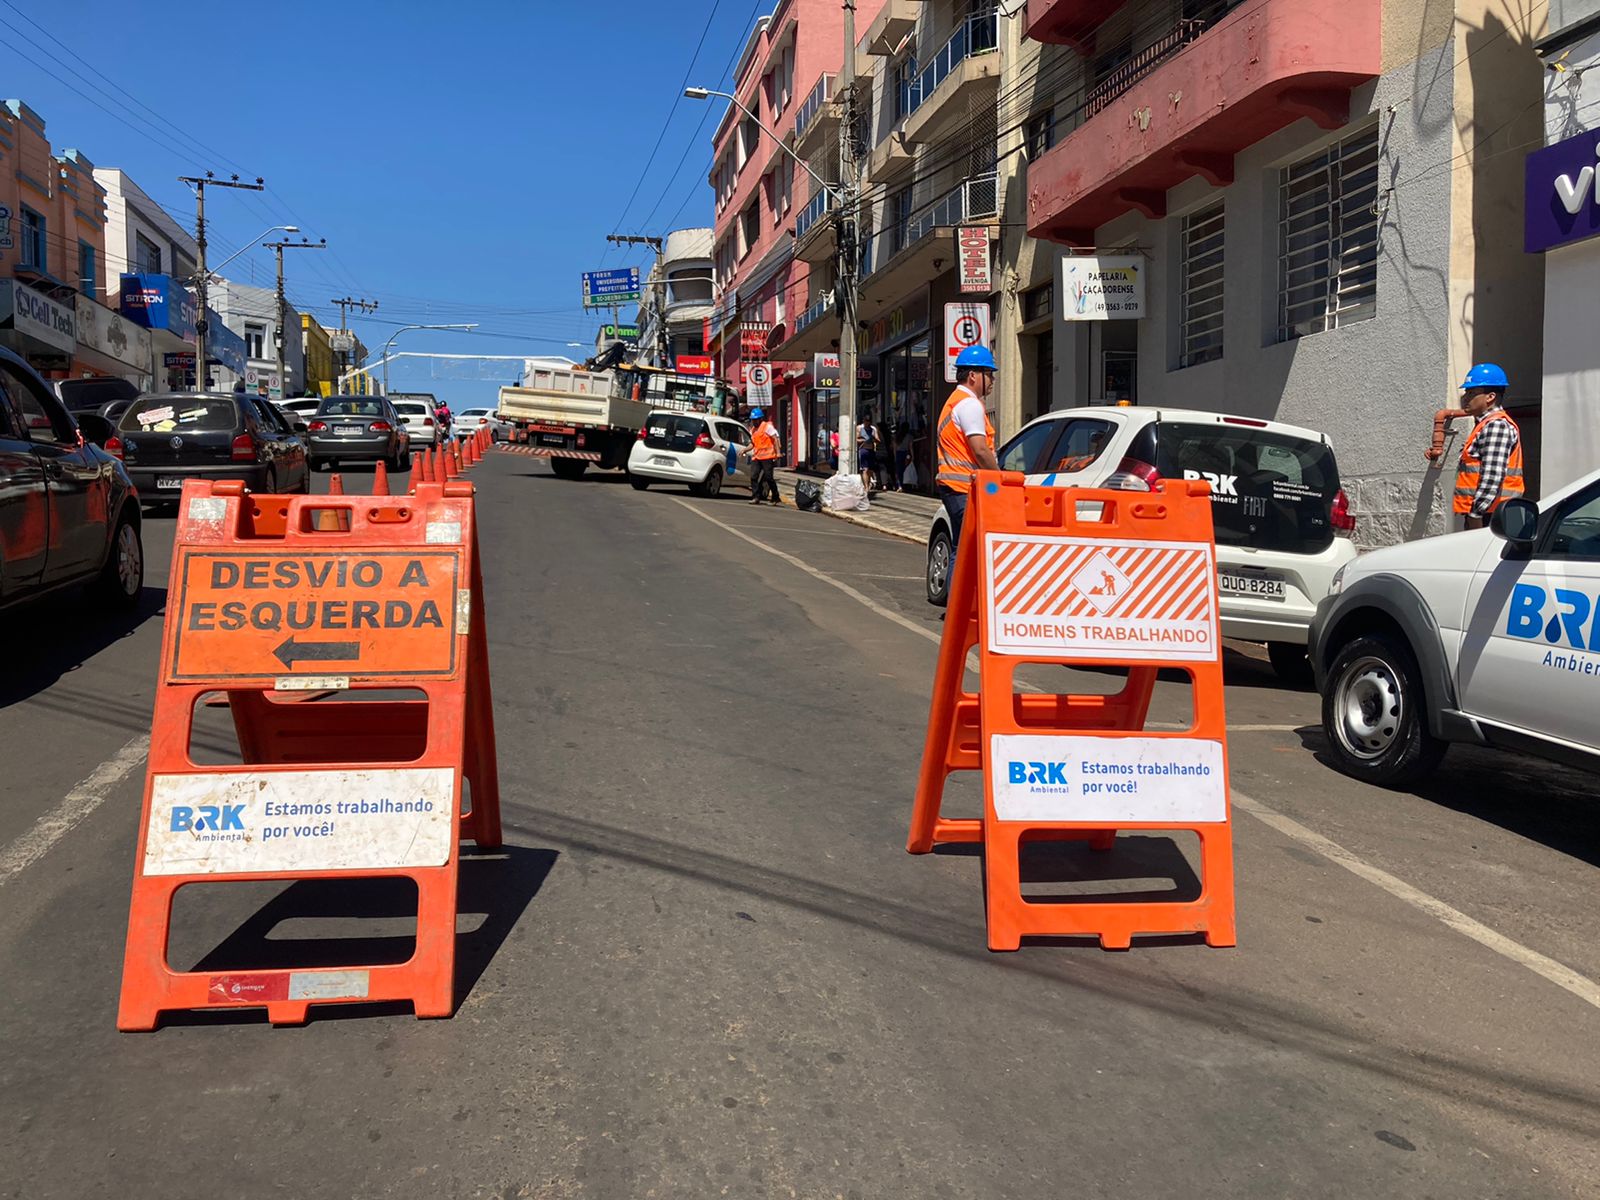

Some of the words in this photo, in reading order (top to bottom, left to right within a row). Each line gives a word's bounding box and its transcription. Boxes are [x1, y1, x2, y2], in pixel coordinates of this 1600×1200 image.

[960, 227, 988, 278] HOTEL
[1088, 272, 1128, 281] PAPELARIA
[1082, 284, 1134, 296] CAÇADORENSE
[125, 294, 163, 304] SITRON
[30, 297, 50, 327] Cell
[52, 310, 74, 337] Tech
[963, 323, 973, 338] E
[679, 362, 699, 370] Shopping
[700, 361, 709, 369] 10
[755, 369, 762, 381] E
[820, 378, 833, 387] 10
[1208, 495, 1238, 504] mbiental
[1243, 495, 1268, 517] FIAT
[210, 560, 383, 590] DESVIO
[398, 560, 430, 588] A
[187, 600, 444, 632] ESQUERDA
[1506, 582, 1600, 655] BR
[1003, 622, 1077, 639] HOMENS
[1081, 625, 1208, 643] TRABALHANDO
[1542, 650, 1600, 676] Ambien
[1008, 761, 1068, 785] BRK
[1081, 761, 1134, 775] Estamos
[1136, 762, 1211, 776] trabalhando
[1030, 786, 1070, 794] Ambiental
[1082, 782, 1103, 796] por
[1106, 780, 1137, 793] você!
[264, 801, 332, 816] Estamos
[336, 798, 433, 816] trabalhando
[169, 804, 247, 832] BRK
[195, 833, 246, 842] Ambiental
[262, 824, 290, 841] por
[293, 821, 335, 837] você!
